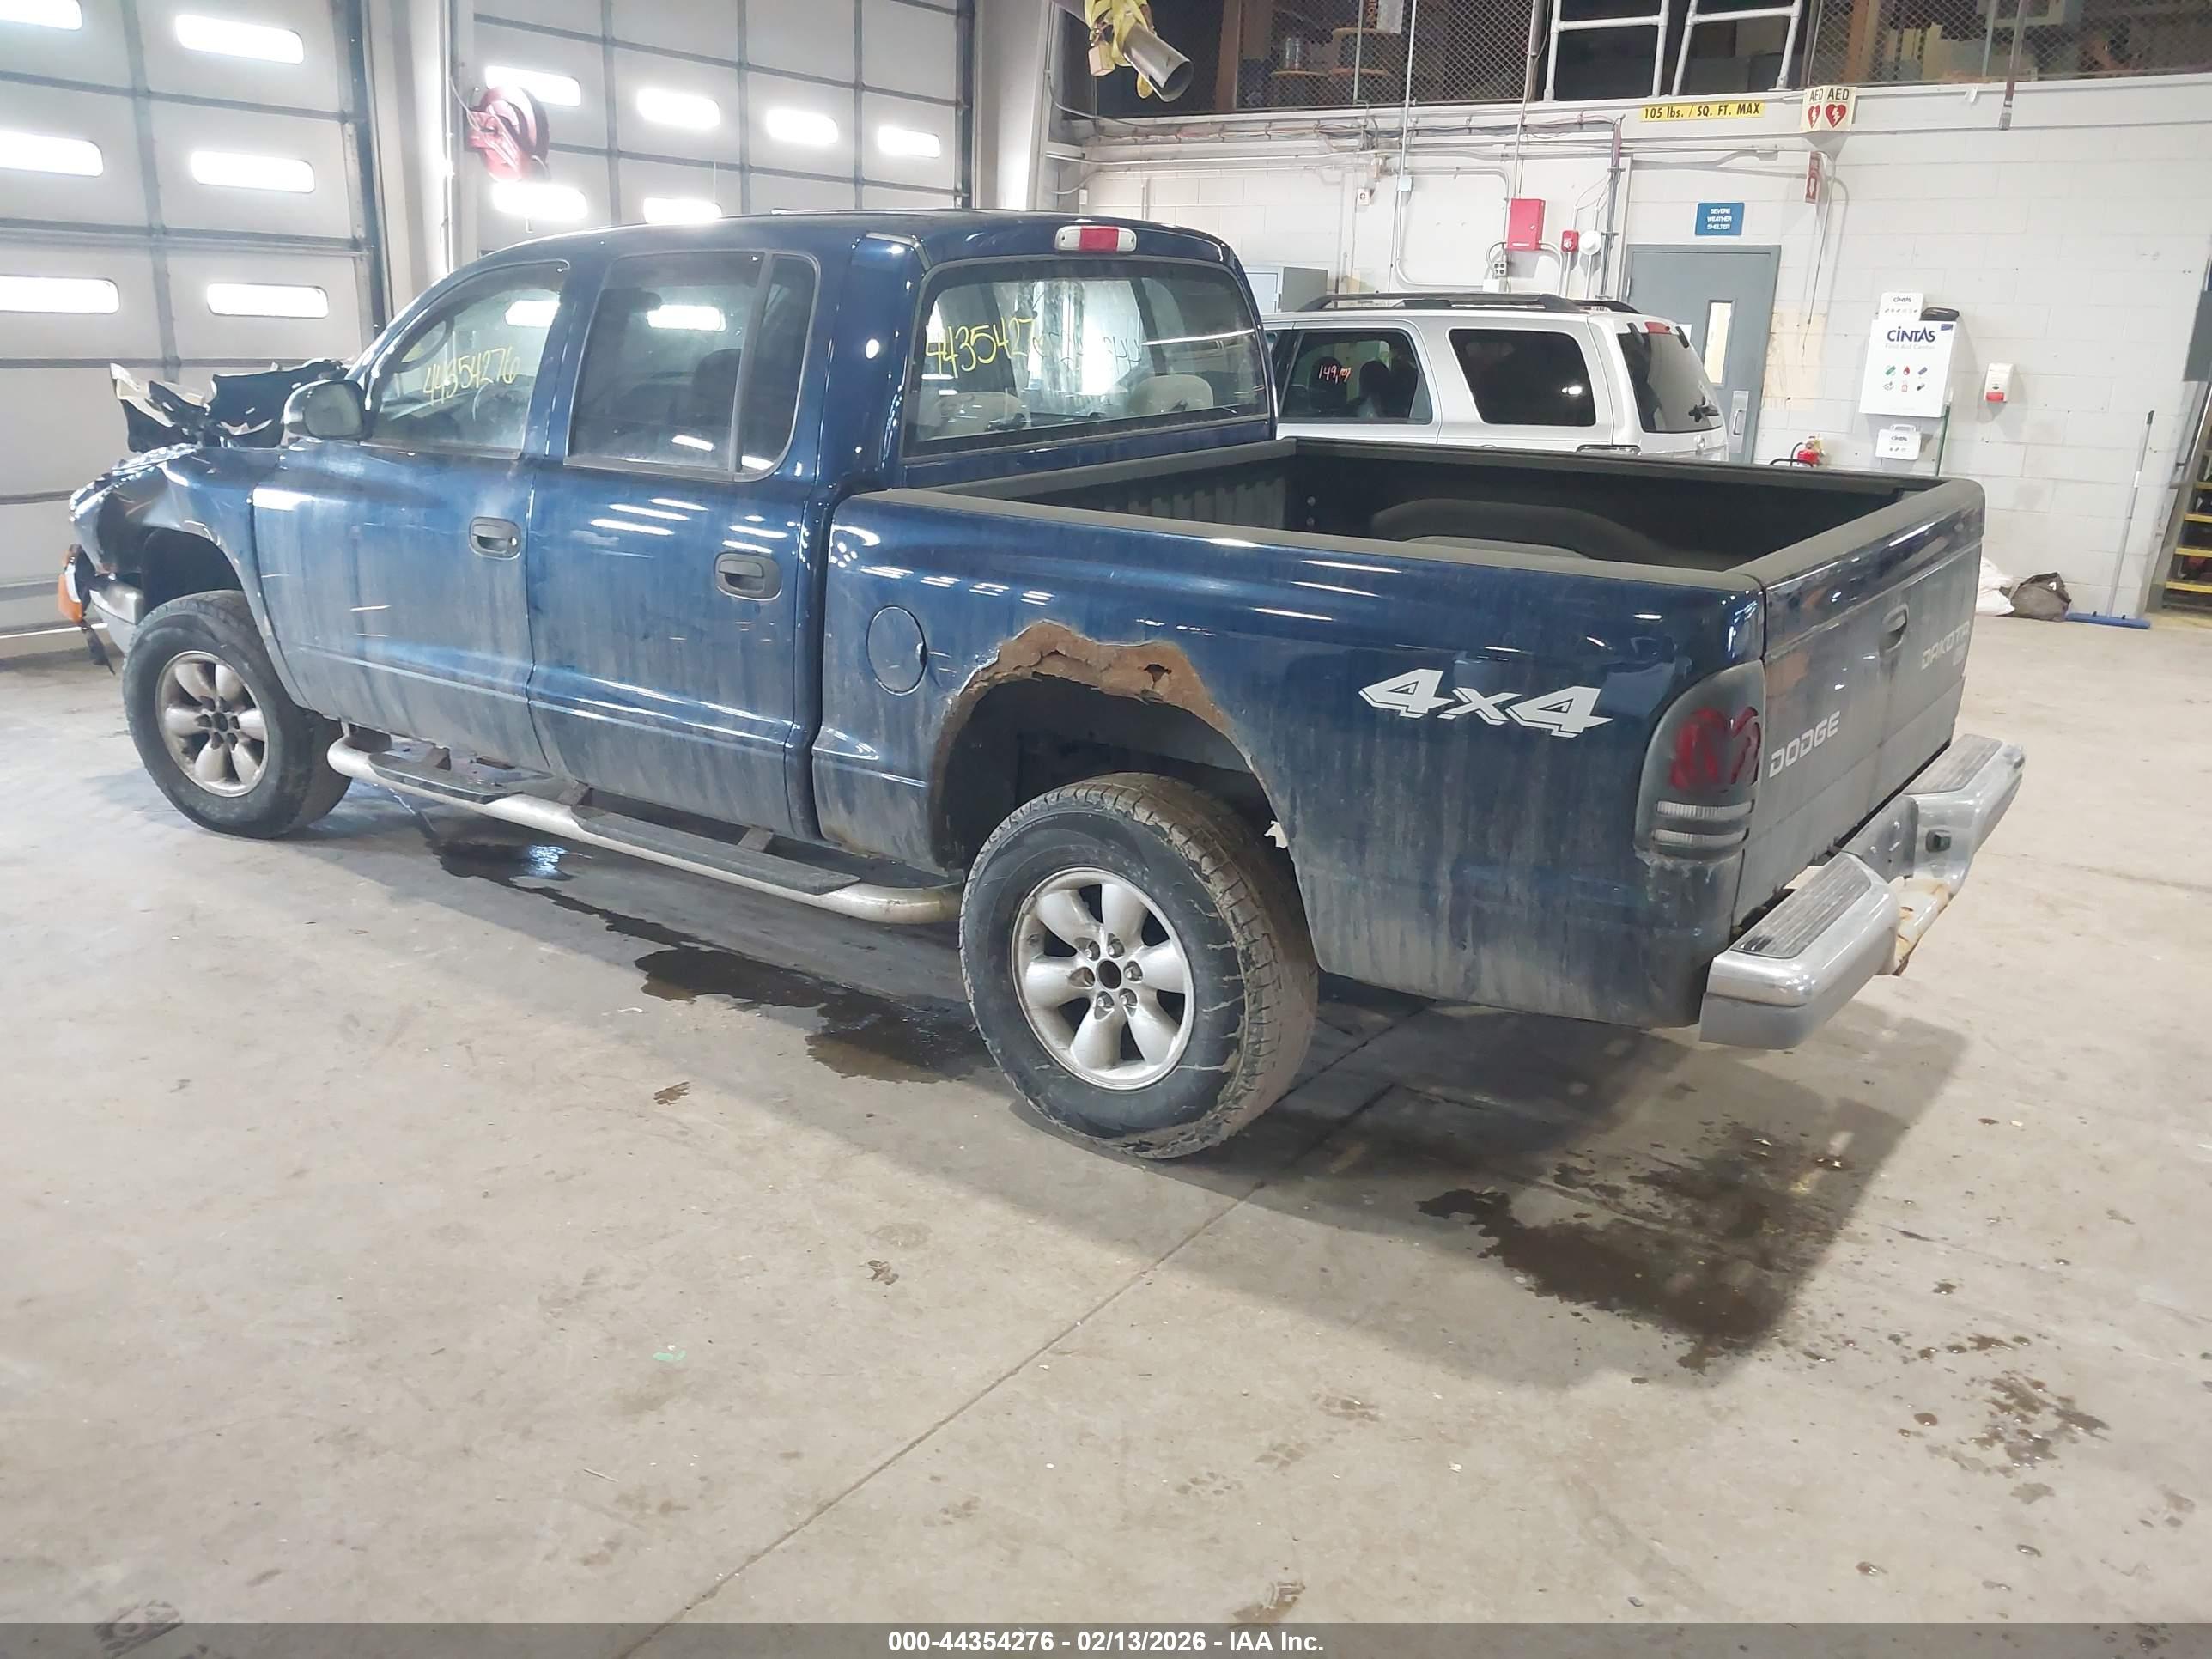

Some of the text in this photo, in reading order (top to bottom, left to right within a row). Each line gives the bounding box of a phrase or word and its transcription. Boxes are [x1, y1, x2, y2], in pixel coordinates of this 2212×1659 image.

[1644, 106, 1662, 119] 105
[1667, 104, 1684, 118] lbs.
[1697, 104, 1712, 118] SQ.
[1717, 102, 1731, 116] FT.
[1736, 102, 1760, 115] MAX
[1809, 89, 1824, 102] AED
[1827, 87, 1850, 101] AED
[423, 346, 520, 405] 44354276
[1922, 620, 1972, 670] DAKOTA
[1769, 710, 1840, 778] DODGE
